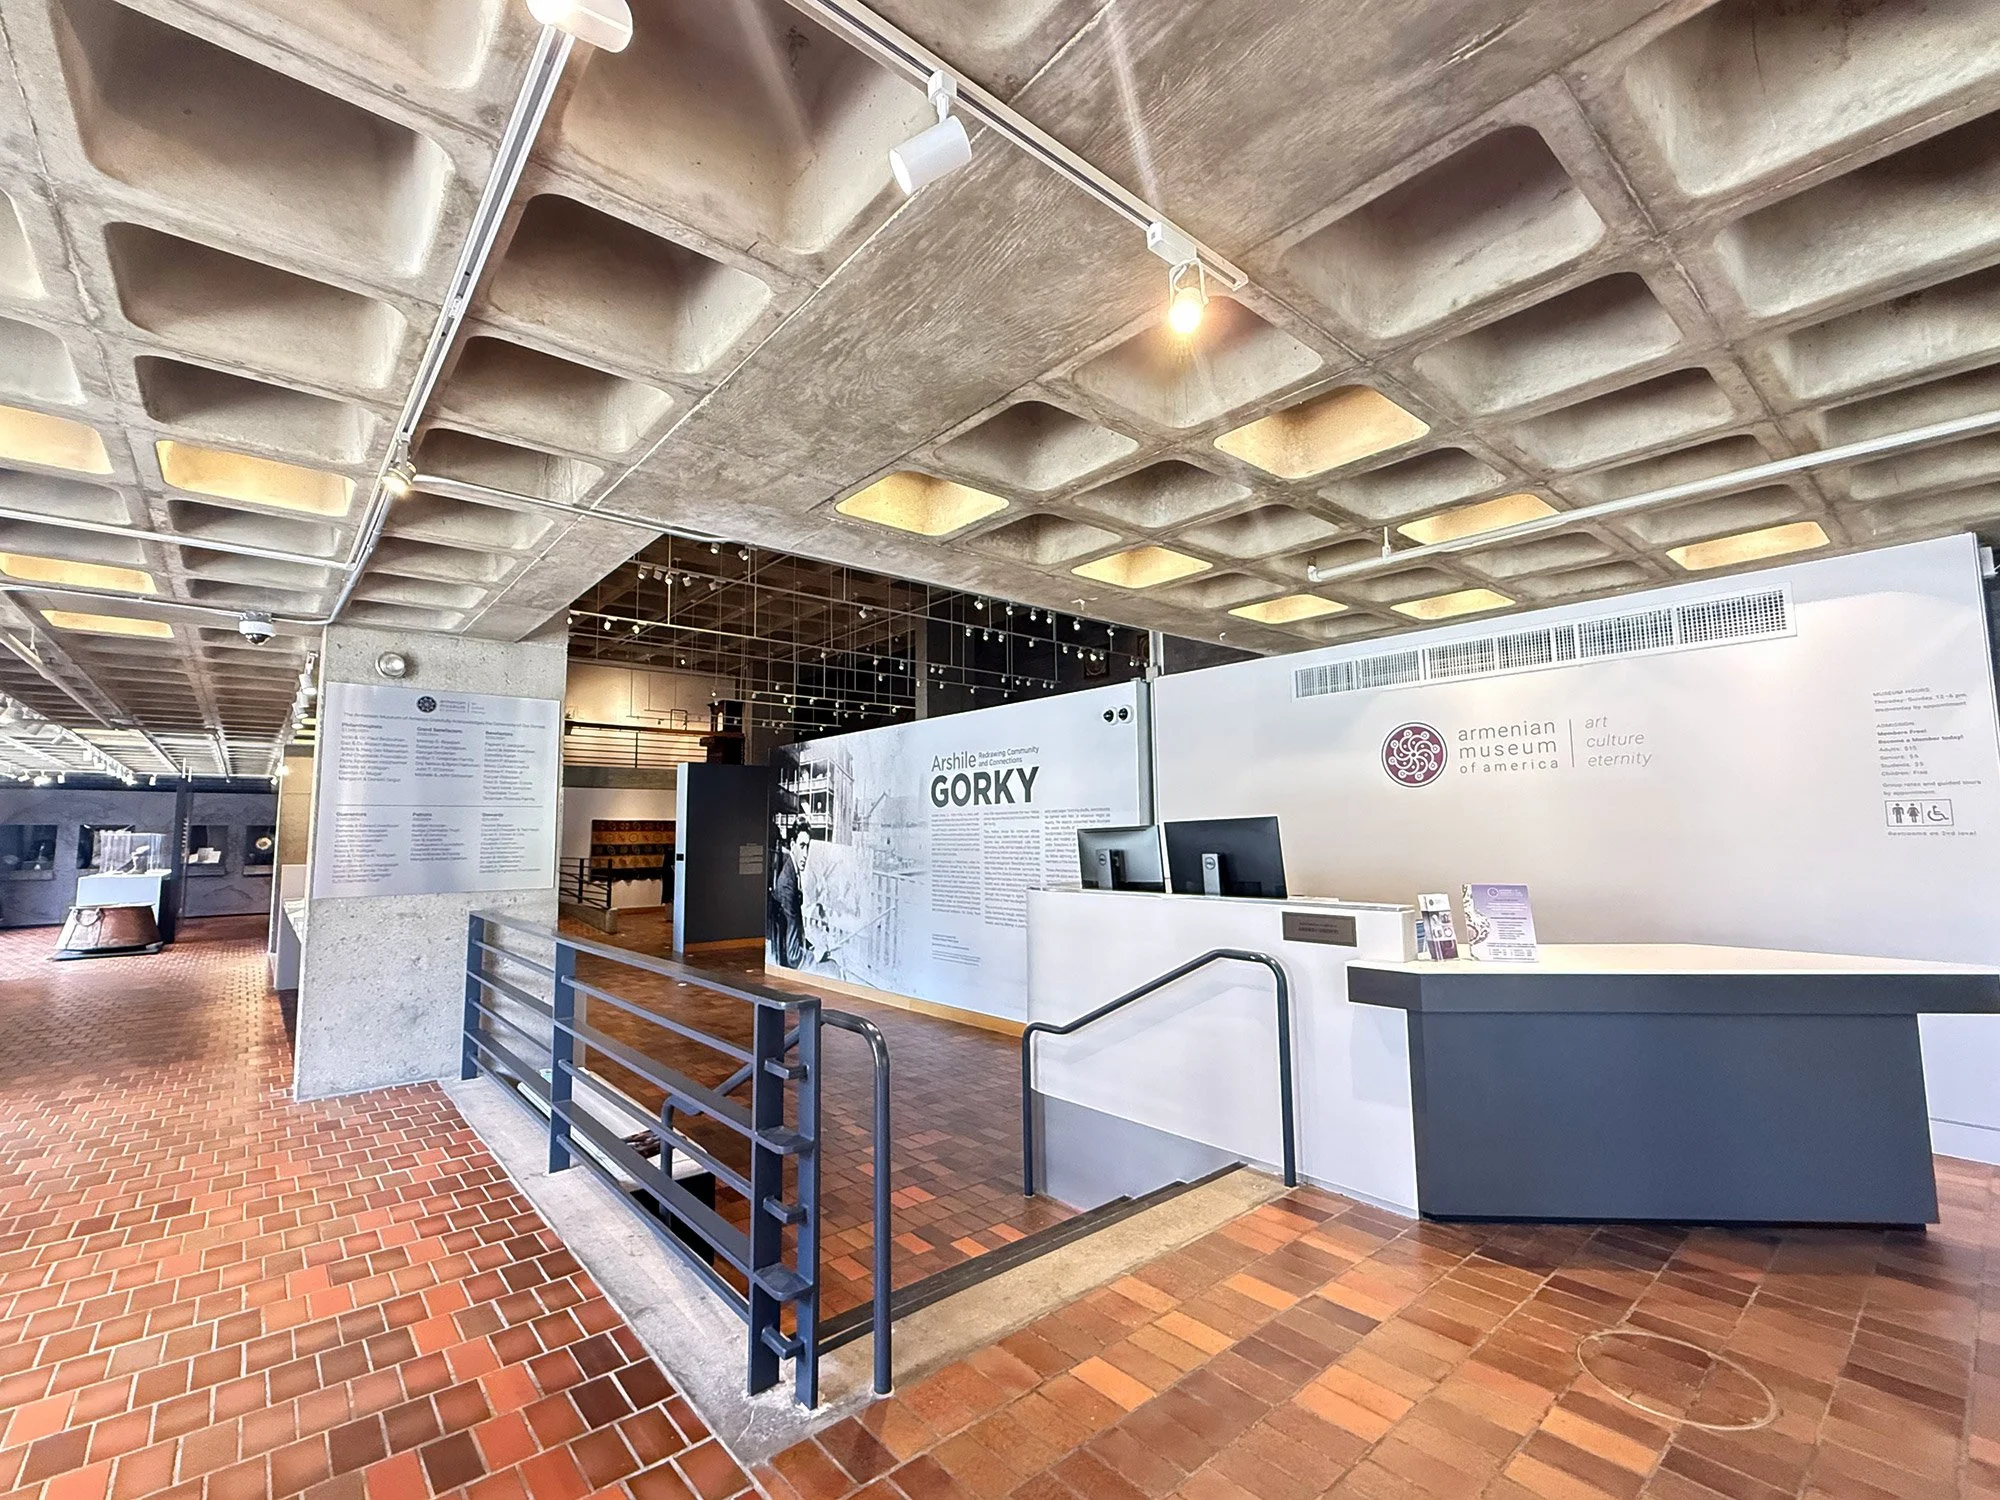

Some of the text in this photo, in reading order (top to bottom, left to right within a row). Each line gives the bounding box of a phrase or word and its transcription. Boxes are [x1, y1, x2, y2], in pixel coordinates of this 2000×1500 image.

[1585, 716, 1608, 729] art
[1458, 720, 1556, 742] armenian
[1586, 733, 1645, 748] culture
[978, 746, 1039, 759] Redrawing Community
[1460, 740, 1557, 759] museum
[931, 751, 976, 772] Arshile
[989, 757, 1022, 766] Connections
[1460, 759, 1559, 774] of america
[1588, 752, 1652, 768] eternity
[931, 766, 1039, 808] GORKY
